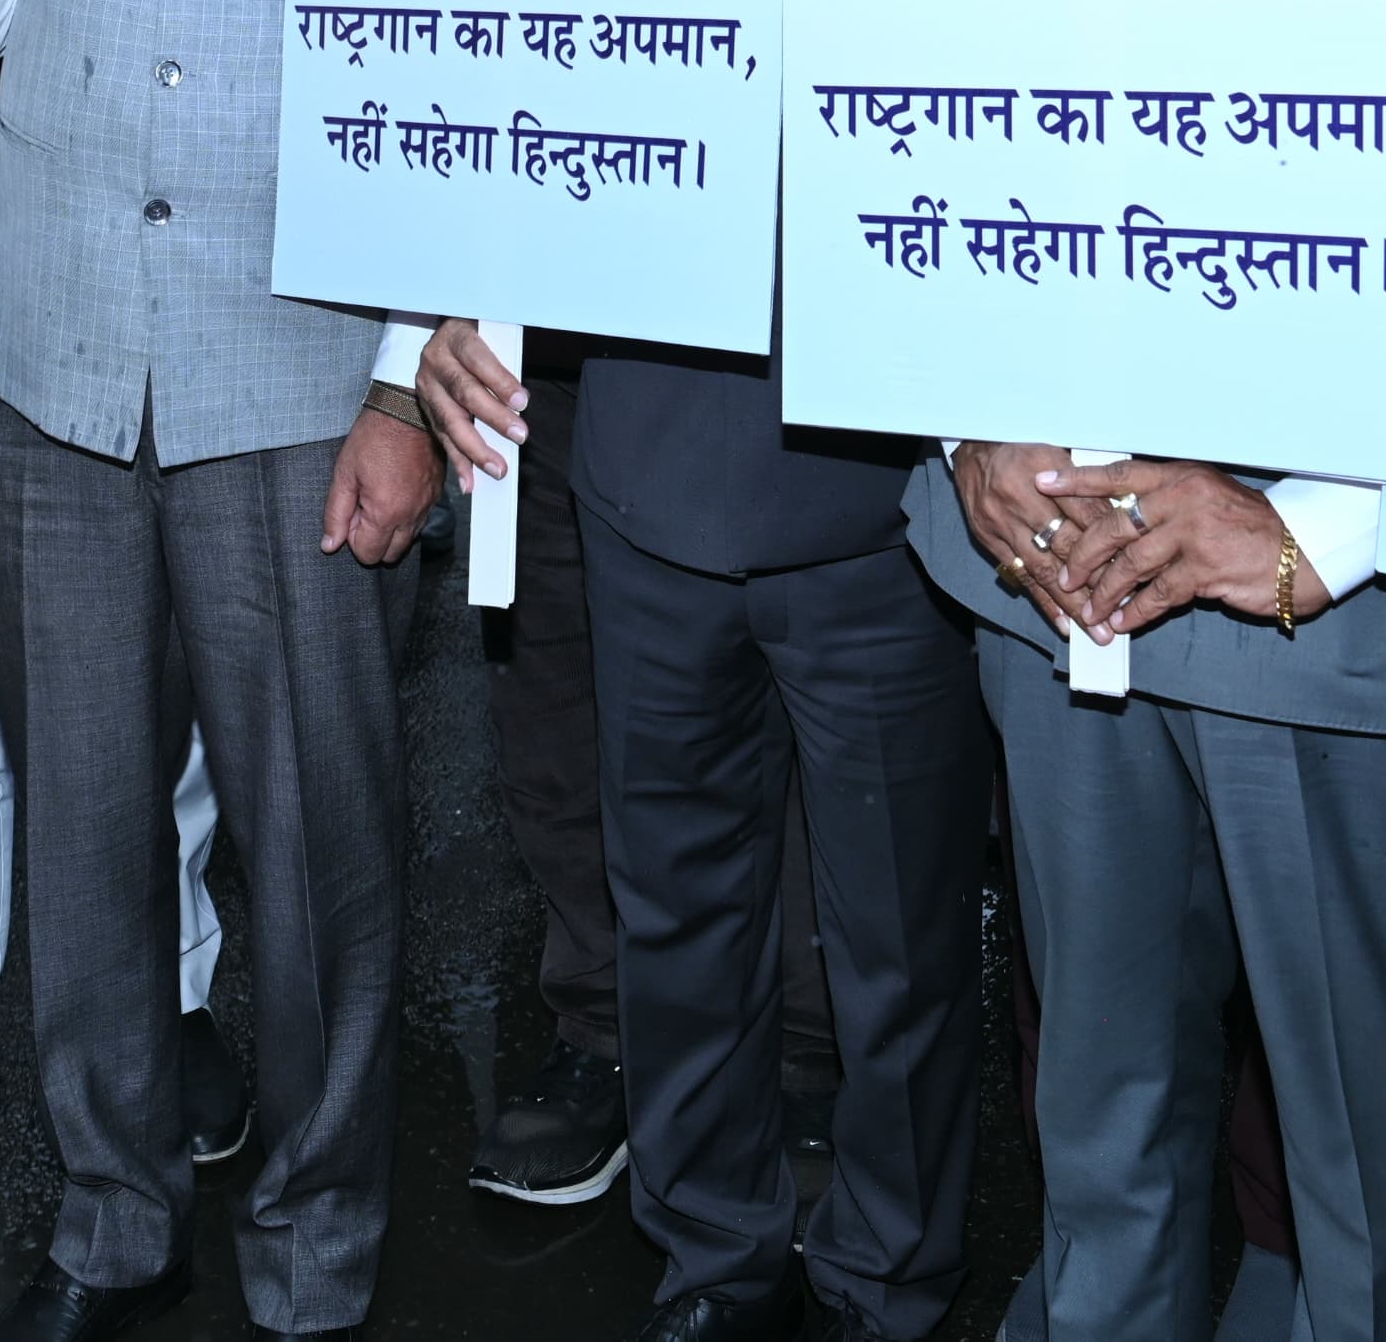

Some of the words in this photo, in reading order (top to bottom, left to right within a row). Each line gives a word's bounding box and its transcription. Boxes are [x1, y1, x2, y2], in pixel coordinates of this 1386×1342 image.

[295, 5, 442, 68] राष्ट्रगान
[451, 11, 510, 58] का
[518, 13, 583, 69] यह
[590, 15, 756, 80] अपमान,
[323, 101, 387, 172] नहीं
[396, 104, 499, 178] सहेगा
[507, 110, 705, 201] हिन्दुस्तान।
[813, 86, 1019, 157] राष्ट्रगान
[1029, 90, 1113, 144] का
[1124, 91, 1215, 157] यह
[858, 195, 948, 278] नहीं
[959, 198, 1105, 285] सहेगा
